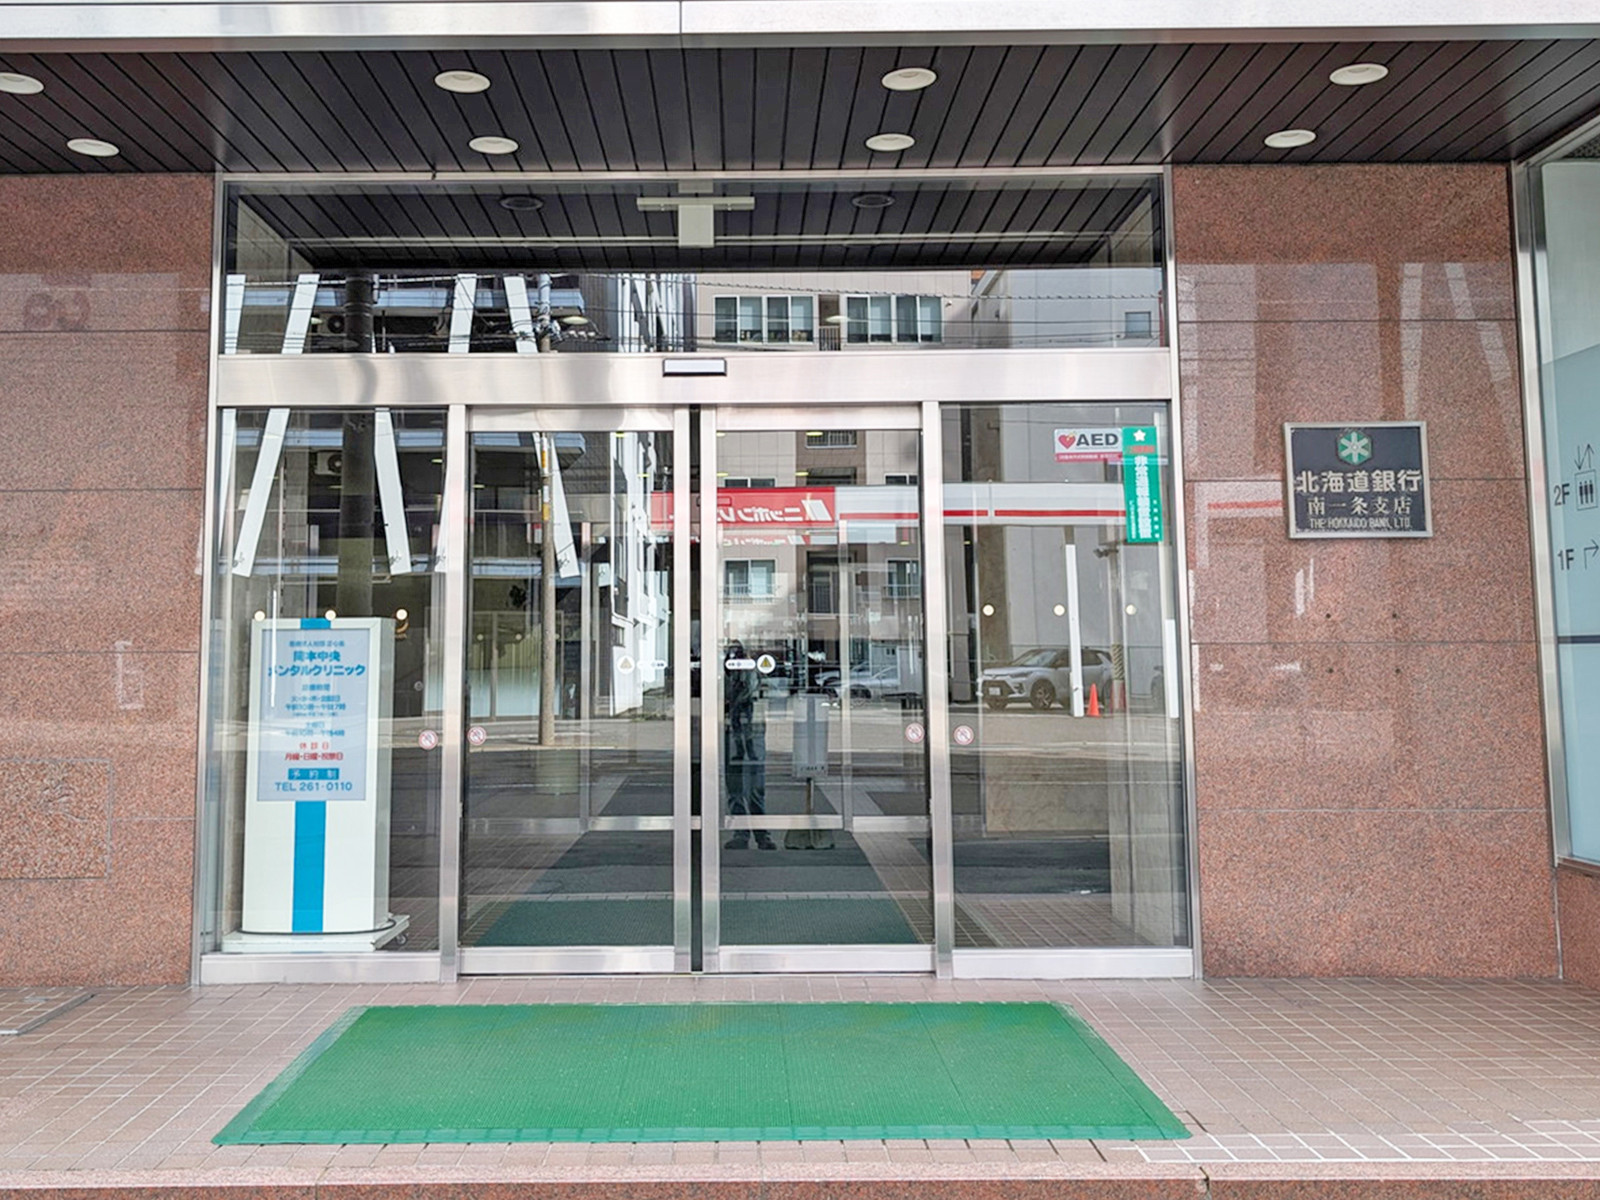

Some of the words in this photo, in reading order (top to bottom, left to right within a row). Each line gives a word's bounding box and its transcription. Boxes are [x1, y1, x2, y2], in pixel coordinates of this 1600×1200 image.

[1076, 433, 1119, 446] AED
[1296, 469, 1422, 493] 北海道銀行
[1553, 484, 1571, 506] 2F
[1307, 496, 1412, 515] 南一条支店
[1328, 518, 1368, 529] HOKKAIDO
[1557, 549, 1575, 570] 1F
[275, 782, 296, 792] TEL
